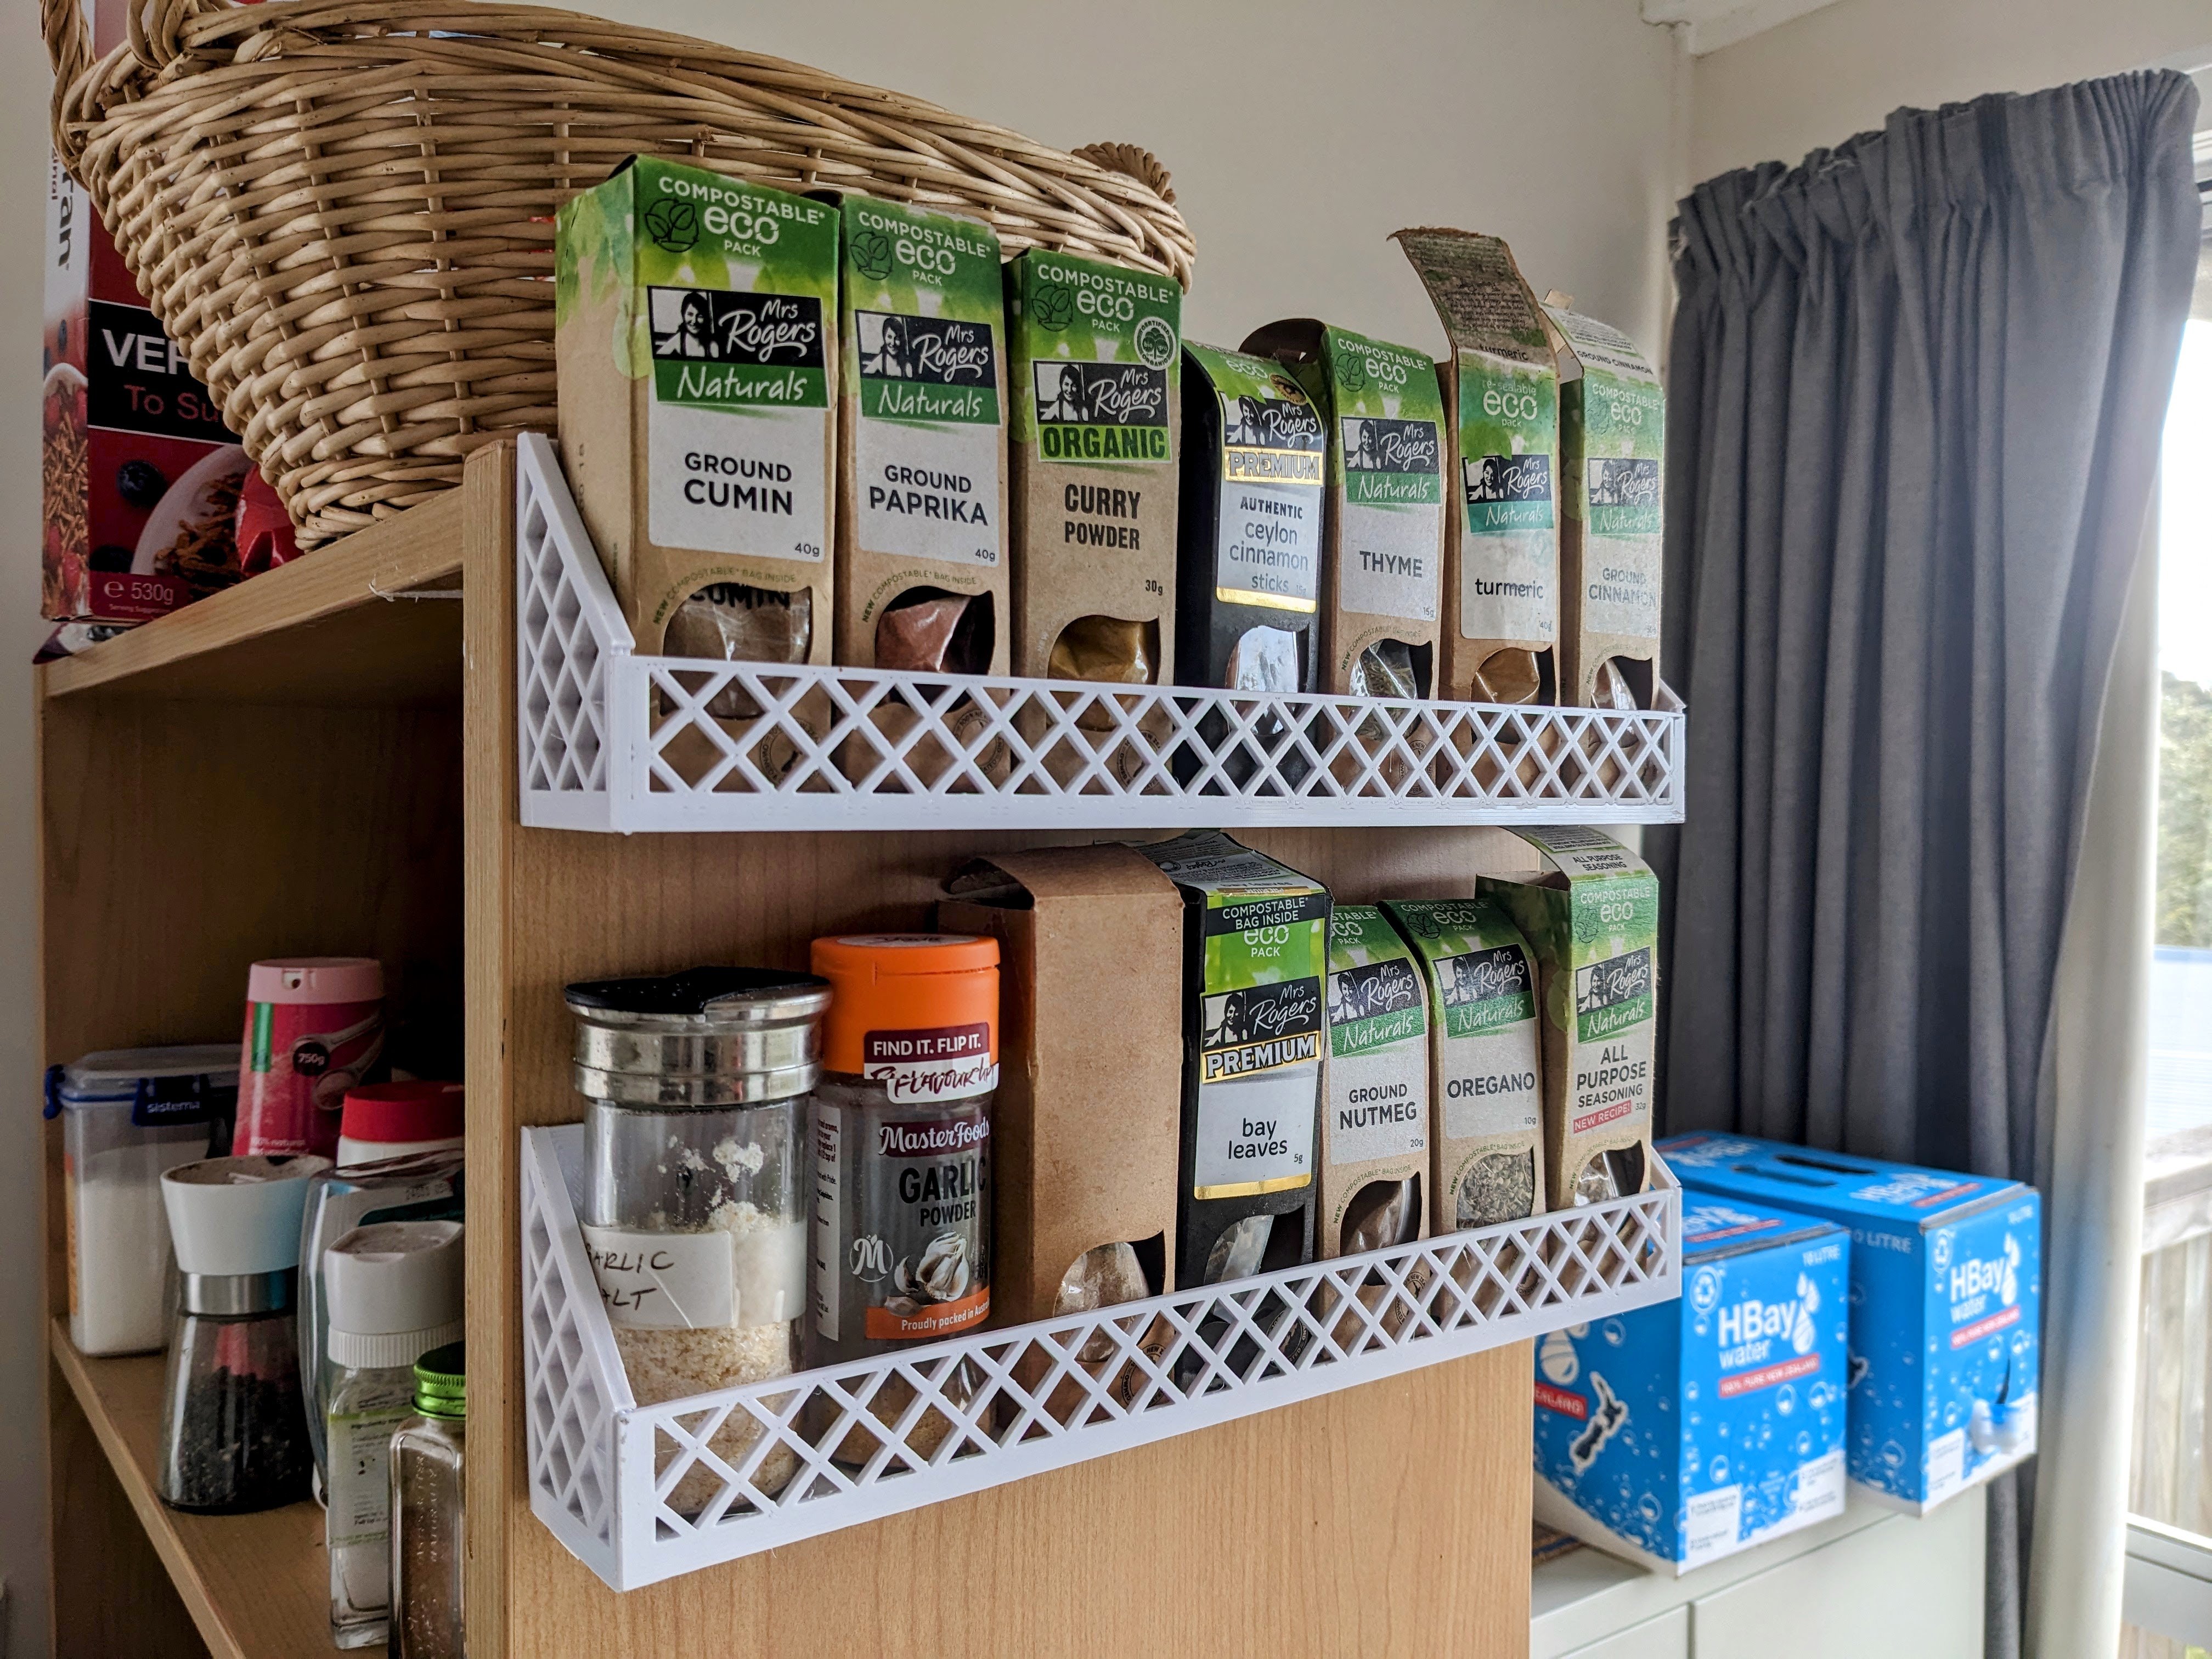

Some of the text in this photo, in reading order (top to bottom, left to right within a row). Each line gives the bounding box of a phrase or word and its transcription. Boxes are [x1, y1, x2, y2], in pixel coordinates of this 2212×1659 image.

[704, 207, 779, 245] eco
[725, 241, 761, 257] PACK
[895, 240, 956, 275] eco
[913, 270, 942, 286] PACK
[761, 298, 798, 322] Mrs
[1077, 290, 1134, 321] eco
[718, 311, 816, 363] Rogers
[946, 325, 974, 345] Mrs
[1092, 319, 1120, 332] PACK
[912, 334, 989, 382] Rogers
[1226, 360, 1268, 379] eco
[1577, 351, 1611, 364] GROUND
[677, 366, 808, 400] Naturals
[1121, 368, 1149, 388] Mrs
[1365, 358, 1407, 384] eco
[123, 385, 164, 414] To
[1379, 382, 1399, 393] PACK
[879, 384, 983, 417] Naturals
[1088, 379, 1163, 424] Rogers
[1282, 403, 1302, 417] Mrs
[1483, 391, 1537, 420] eco
[1502, 418, 1522, 428] pack
[1611, 402, 1641, 425] eco
[1262, 409, 1317, 448] Rogers
[1403, 424, 1424, 441] Mrs
[1043, 427, 1165, 459] ORGANIC
[1380, 433, 1435, 471] Rogers
[685, 453, 792, 482] GROUND
[1229, 450, 1319, 480] PREMIUM
[1523, 458, 1540, 473] Mrs
[885, 465, 972, 493] GROUND
[1358, 475, 1430, 500] Naturals
[1502, 466, 1548, 499] Rogers
[1617, 471, 1656, 505] Rogers
[685, 479, 793, 516] CUMIN
[870, 486, 988, 526] PAPRIKA
[1065, 484, 1141, 519] CURRY
[1240, 496, 1303, 520] AUTHENTIC
[1486, 505, 1544, 526] Naturals
[1065, 521, 1140, 550] POWDER
[1245, 521, 1297, 546] ceylon
[795, 543, 820, 557] 40g
[975, 549, 996, 562] 40g
[1229, 541, 1308, 571] cinnamon
[742, 569, 762, 581] BAG
[765, 572, 796, 583] INSIDE
[1359, 551, 1423, 578] THYME
[1602, 567, 1646, 585] GROUND
[131, 583, 173, 605] 530g
[1146, 579, 1163, 596] 30g
[1252, 573, 1289, 593] sticks
[1475, 578, 1543, 599] turmeric
[1589, 584, 1656, 606] CINNAMON
[862, 599, 874, 623] NEW
[934, 572, 950, 582] BAG
[952, 577, 977, 585] INSIDE
[1423, 607, 1434, 617] 15g
[1341, 651, 1351, 671] NEW
[1583, 862, 1627, 871] SEASONING
[1235, 910, 1299, 930] BAG INSIDE
[1433, 910, 1476, 924] eco
[1600, 902, 1633, 923] eco
[1244, 924, 1289, 945] eco
[1251, 947, 1280, 957] PACK
[1493, 950, 1511, 967] Mrs
[1625, 955, 1641, 972] Mrs
[1380, 964, 1400, 982] Mrs
[1474, 960, 1525, 995] Rogers
[1607, 964, 1648, 999] Rogers
[1279, 985, 1304, 1004] Mrs
[1361, 974, 1413, 1012] Rogers
[1249, 997, 1317, 1035] Rogers
[1458, 998, 1524, 1031] Naturals
[1588, 998, 1645, 1037] Naturals
[1344, 1012, 1413, 1051] Naturals
[873, 1034, 981, 1056] FIND IT. FLIP IT.
[1205, 1034, 1318, 1080] PREMIUM
[1600, 1045, 1628, 1064] ALL
[298, 1053, 325, 1065] 750g
[1447, 1072, 1534, 1098] OREGANO
[1577, 1061, 1646, 1091] PURPOSE
[1349, 1084, 1407, 1103] GROUND
[1578, 1084, 1643, 1108] SEASONING
[148, 1101, 200, 1114] sistema
[1340, 1102, 1417, 1130] NUTMEG
[1575, 1102, 1630, 1131] NEW RECIPE!
[879, 1116, 989, 1154] MasterFoods
[1242, 1118, 1277, 1140] bay
[1228, 1140, 1303, 1164] leaves 5g
[1410, 1138, 1424, 1148] 20g
[899, 1155, 987, 1204] GARLIC
[1450, 1176, 1458, 1195] NEW
[1508, 1141, 1525, 1149] INSIDE
[1334, 1204, 1342, 1223] NEW
[1382, 1166, 1393, 1175] BAG
[1395, 1164, 1412, 1174] INSIDE
[920, 1200, 977, 1227] POWDER
[1950, 1257, 2004, 1302] HBay
[902, 1308, 974, 1331] Proudly packed in
[1718, 1299, 1798, 1347] HBay
[1719, 1339, 1771, 1369] water
